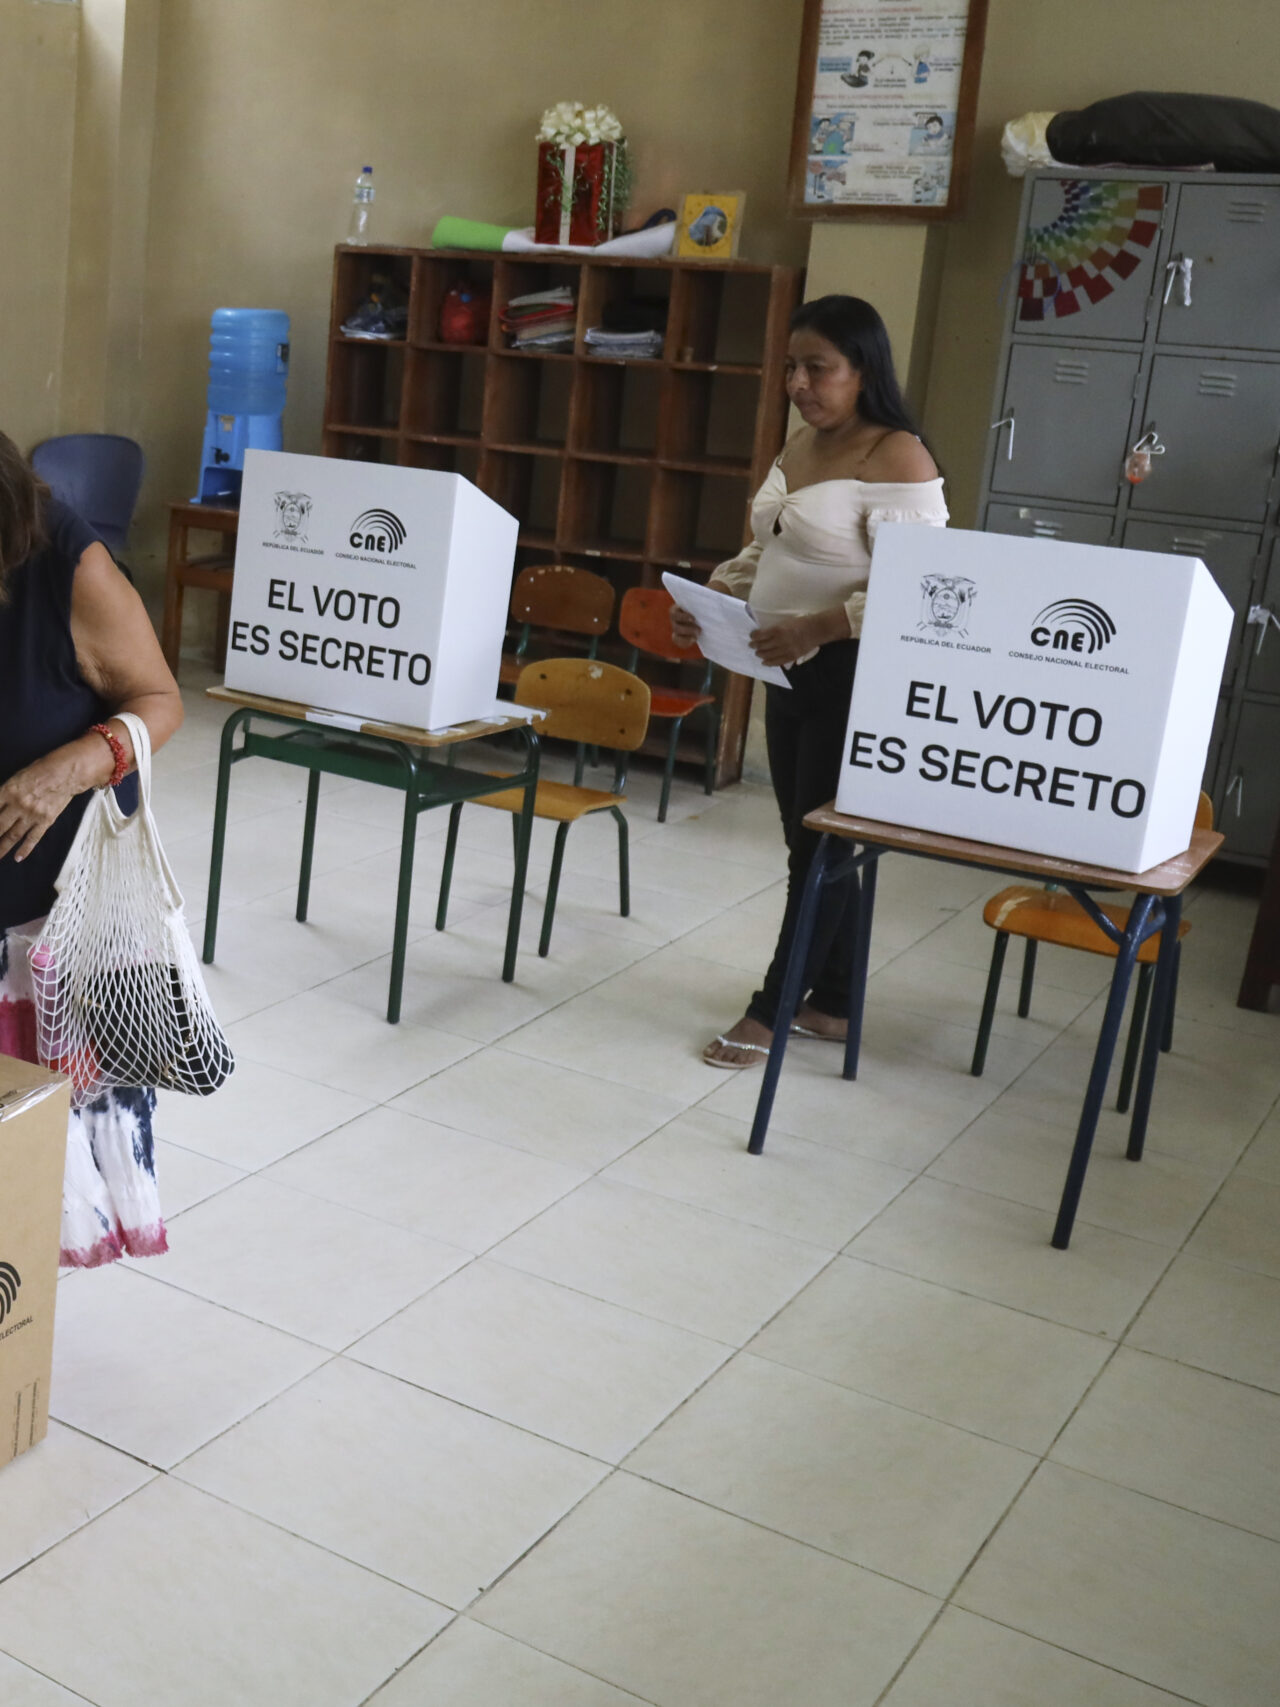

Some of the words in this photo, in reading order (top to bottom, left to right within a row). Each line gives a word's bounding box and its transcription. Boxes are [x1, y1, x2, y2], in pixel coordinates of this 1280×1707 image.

[349, 532, 386, 552] CNE
[267, 578, 304, 613] EL
[313, 585, 400, 629] VOTO
[231, 621, 270, 656] ES
[278, 629, 432, 686] SECRETO
[941, 640, 955, 650] DEL
[956, 643, 992, 654] ECUADOR
[1030, 626, 1085, 653] CNE
[1008, 650, 1044, 662] CONSEJO
[1045, 655, 1083, 668] NACIONAL
[1084, 661, 1129, 675] ELECTORAL
[905, 680, 959, 724] EL
[973, 690, 1103, 747] VOTO
[849, 730, 908, 774] ES
[919, 744, 1146, 819] SECRETO
